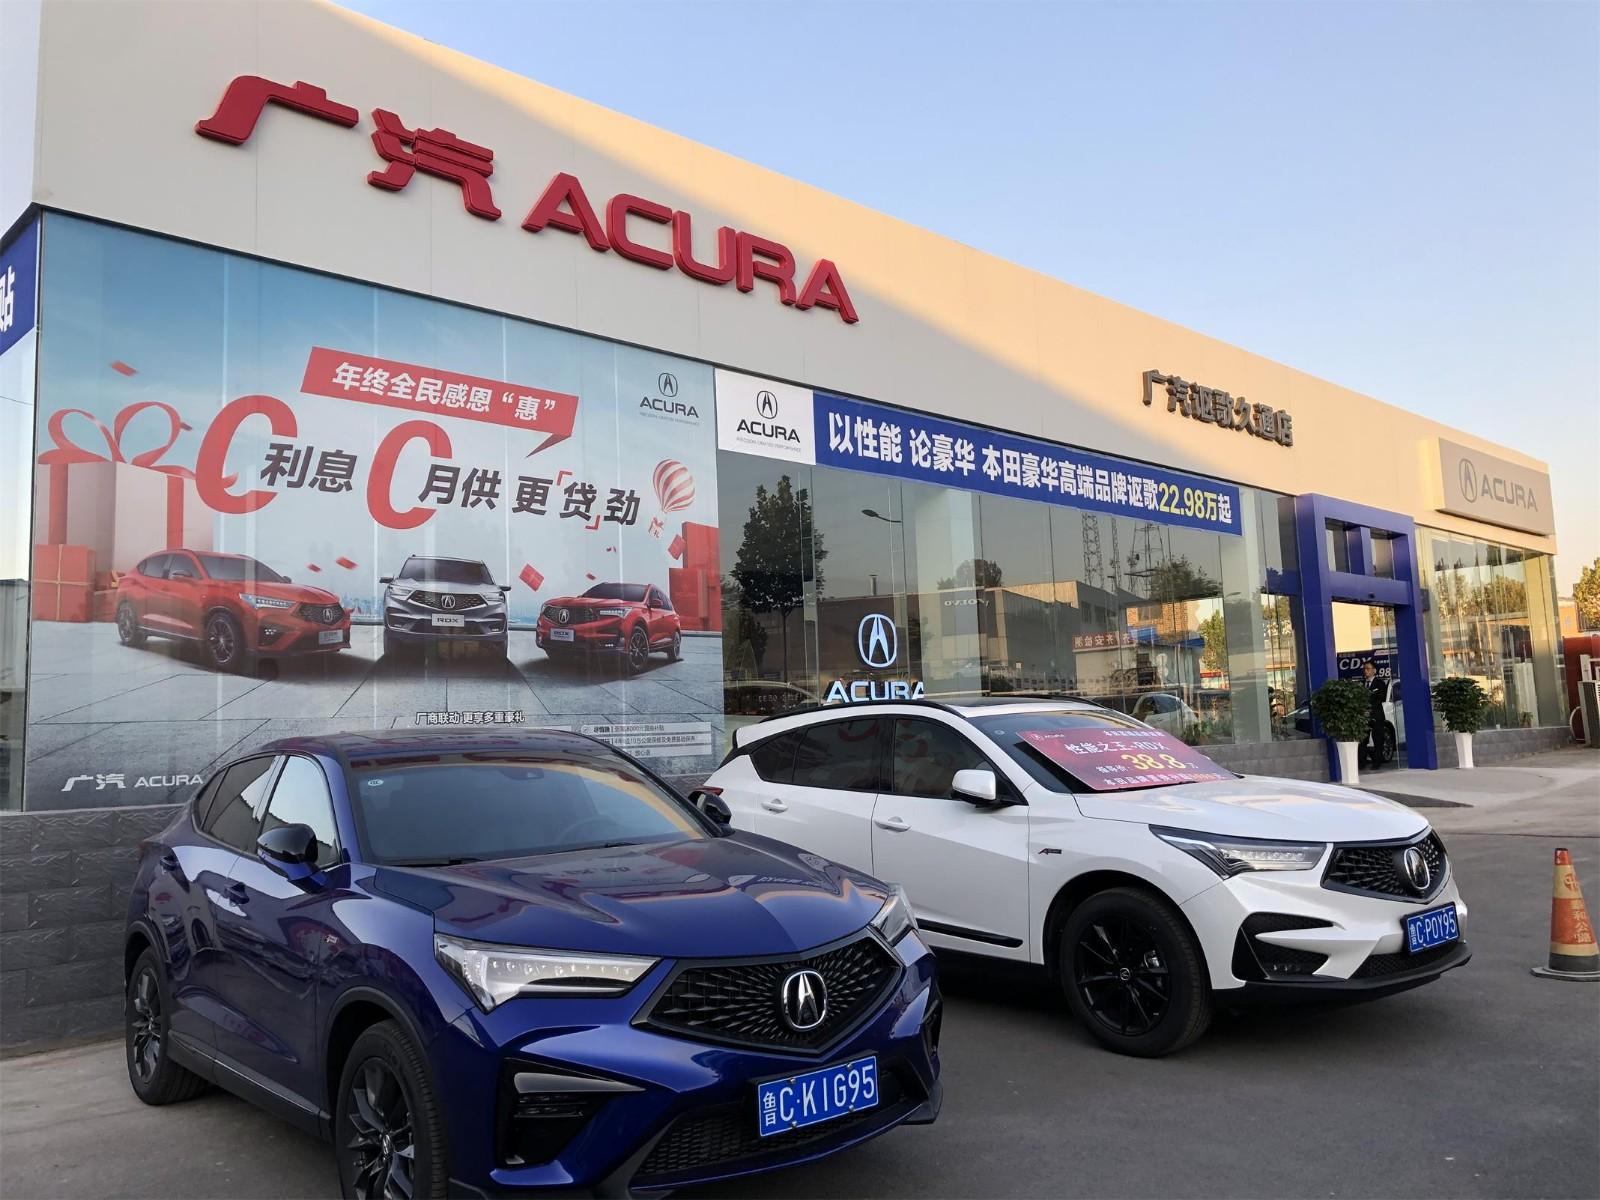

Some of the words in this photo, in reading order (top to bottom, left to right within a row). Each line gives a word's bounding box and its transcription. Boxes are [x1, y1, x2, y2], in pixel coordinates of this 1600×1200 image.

[195, 75, 501, 220] 广汽
[521, 172, 859, 324] ACURA
[639, 396, 699, 418] ACURA
[736, 419, 801, 443] ACURA
[828, 412, 903, 464] 以性能
[909, 428, 975, 476] 论豪华
[982, 443, 1232, 525] 本田豪华高端品牌讴歌22.98万起
[1481, 474, 1538, 512] ACURA
[826, 680, 925, 702] ACURA
[61, 773, 126, 792] 广汽
[134, 774, 204, 788] ACURA
